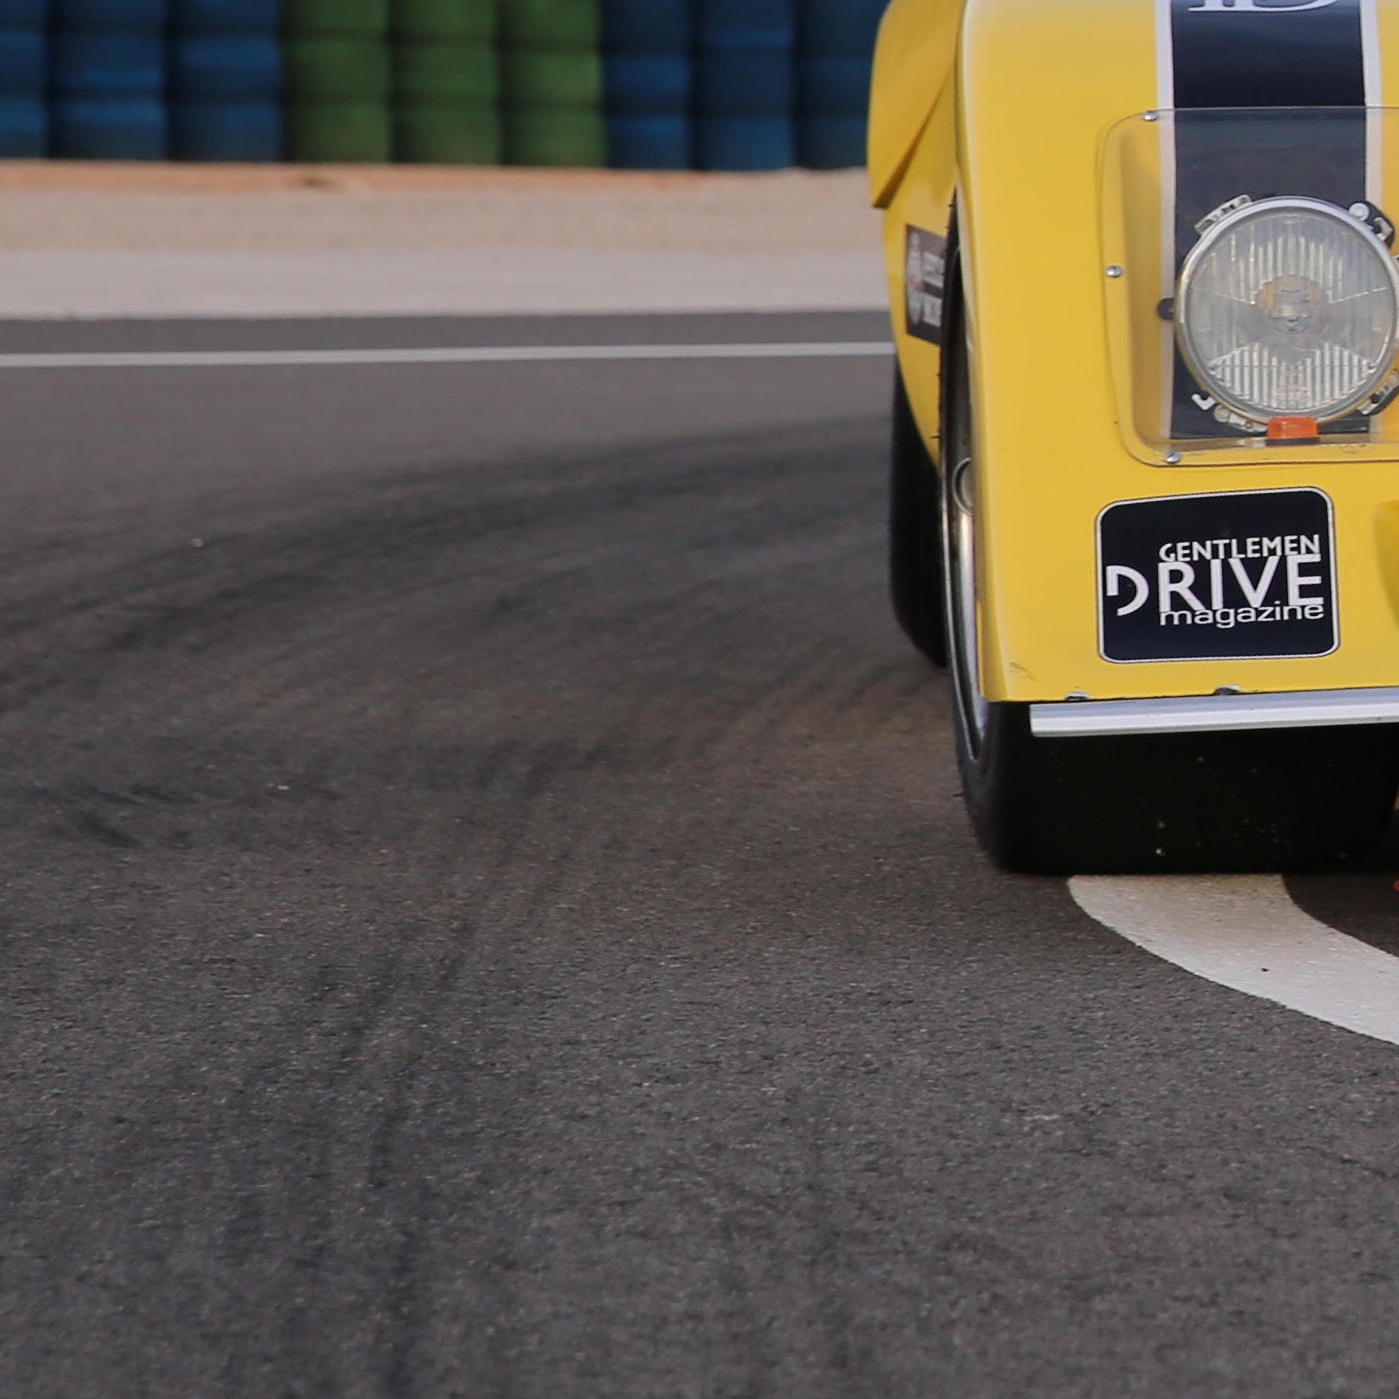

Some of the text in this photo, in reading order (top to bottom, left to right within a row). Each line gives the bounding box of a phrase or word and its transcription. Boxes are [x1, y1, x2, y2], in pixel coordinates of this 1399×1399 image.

[1158, 534, 1320, 563] GENTLEMEN
[1106, 553, 1325, 617] DRIVE
[1159, 600, 1325, 629] magazine
